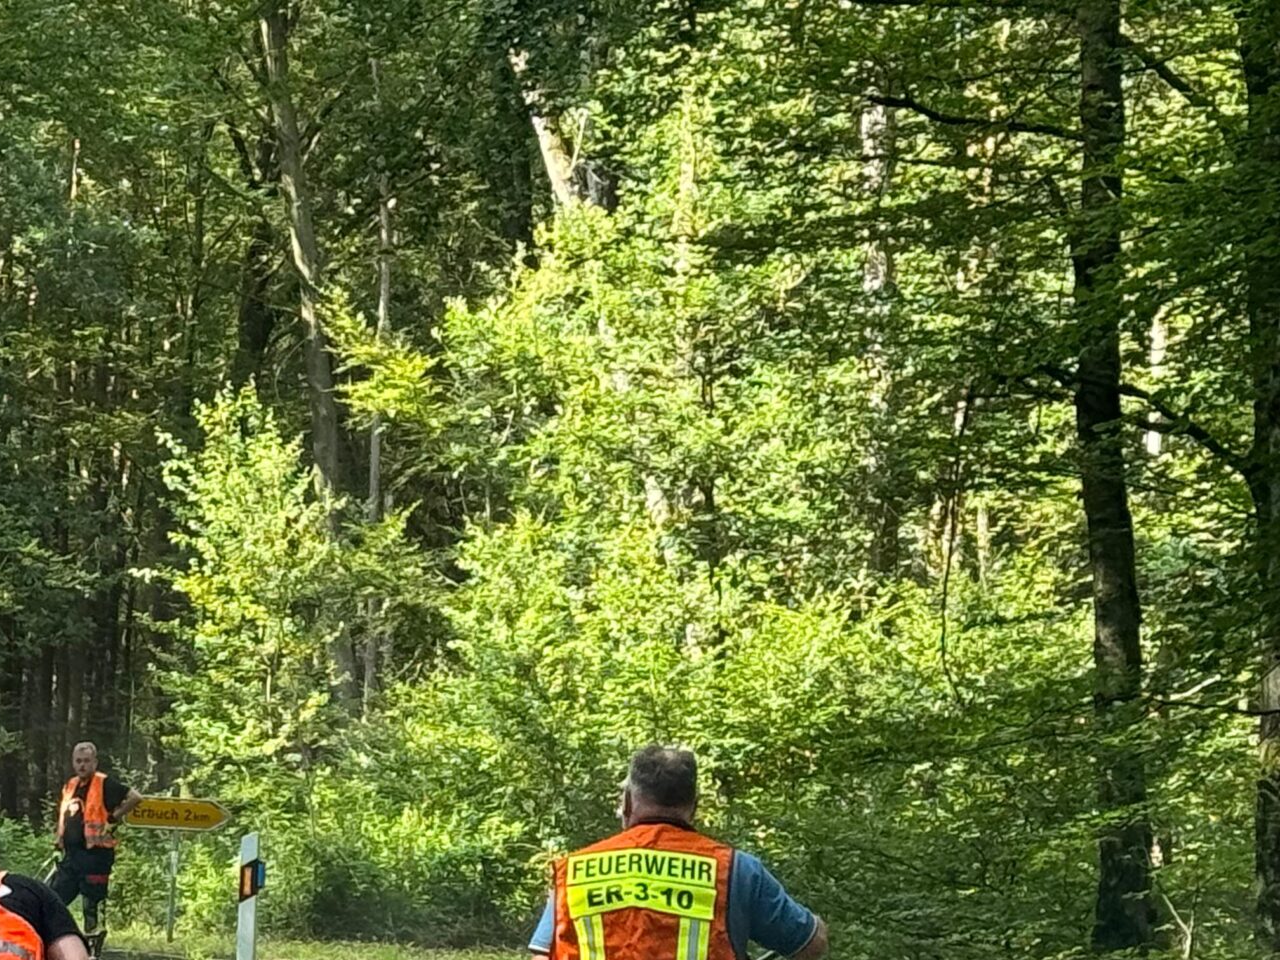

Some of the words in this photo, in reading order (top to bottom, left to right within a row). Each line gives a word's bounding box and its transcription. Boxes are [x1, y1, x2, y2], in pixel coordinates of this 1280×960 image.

[184, 809, 193, 821] 2
[572, 853, 712, 882] FEUERWEHR
[587, 883, 694, 910] ER-3-10
